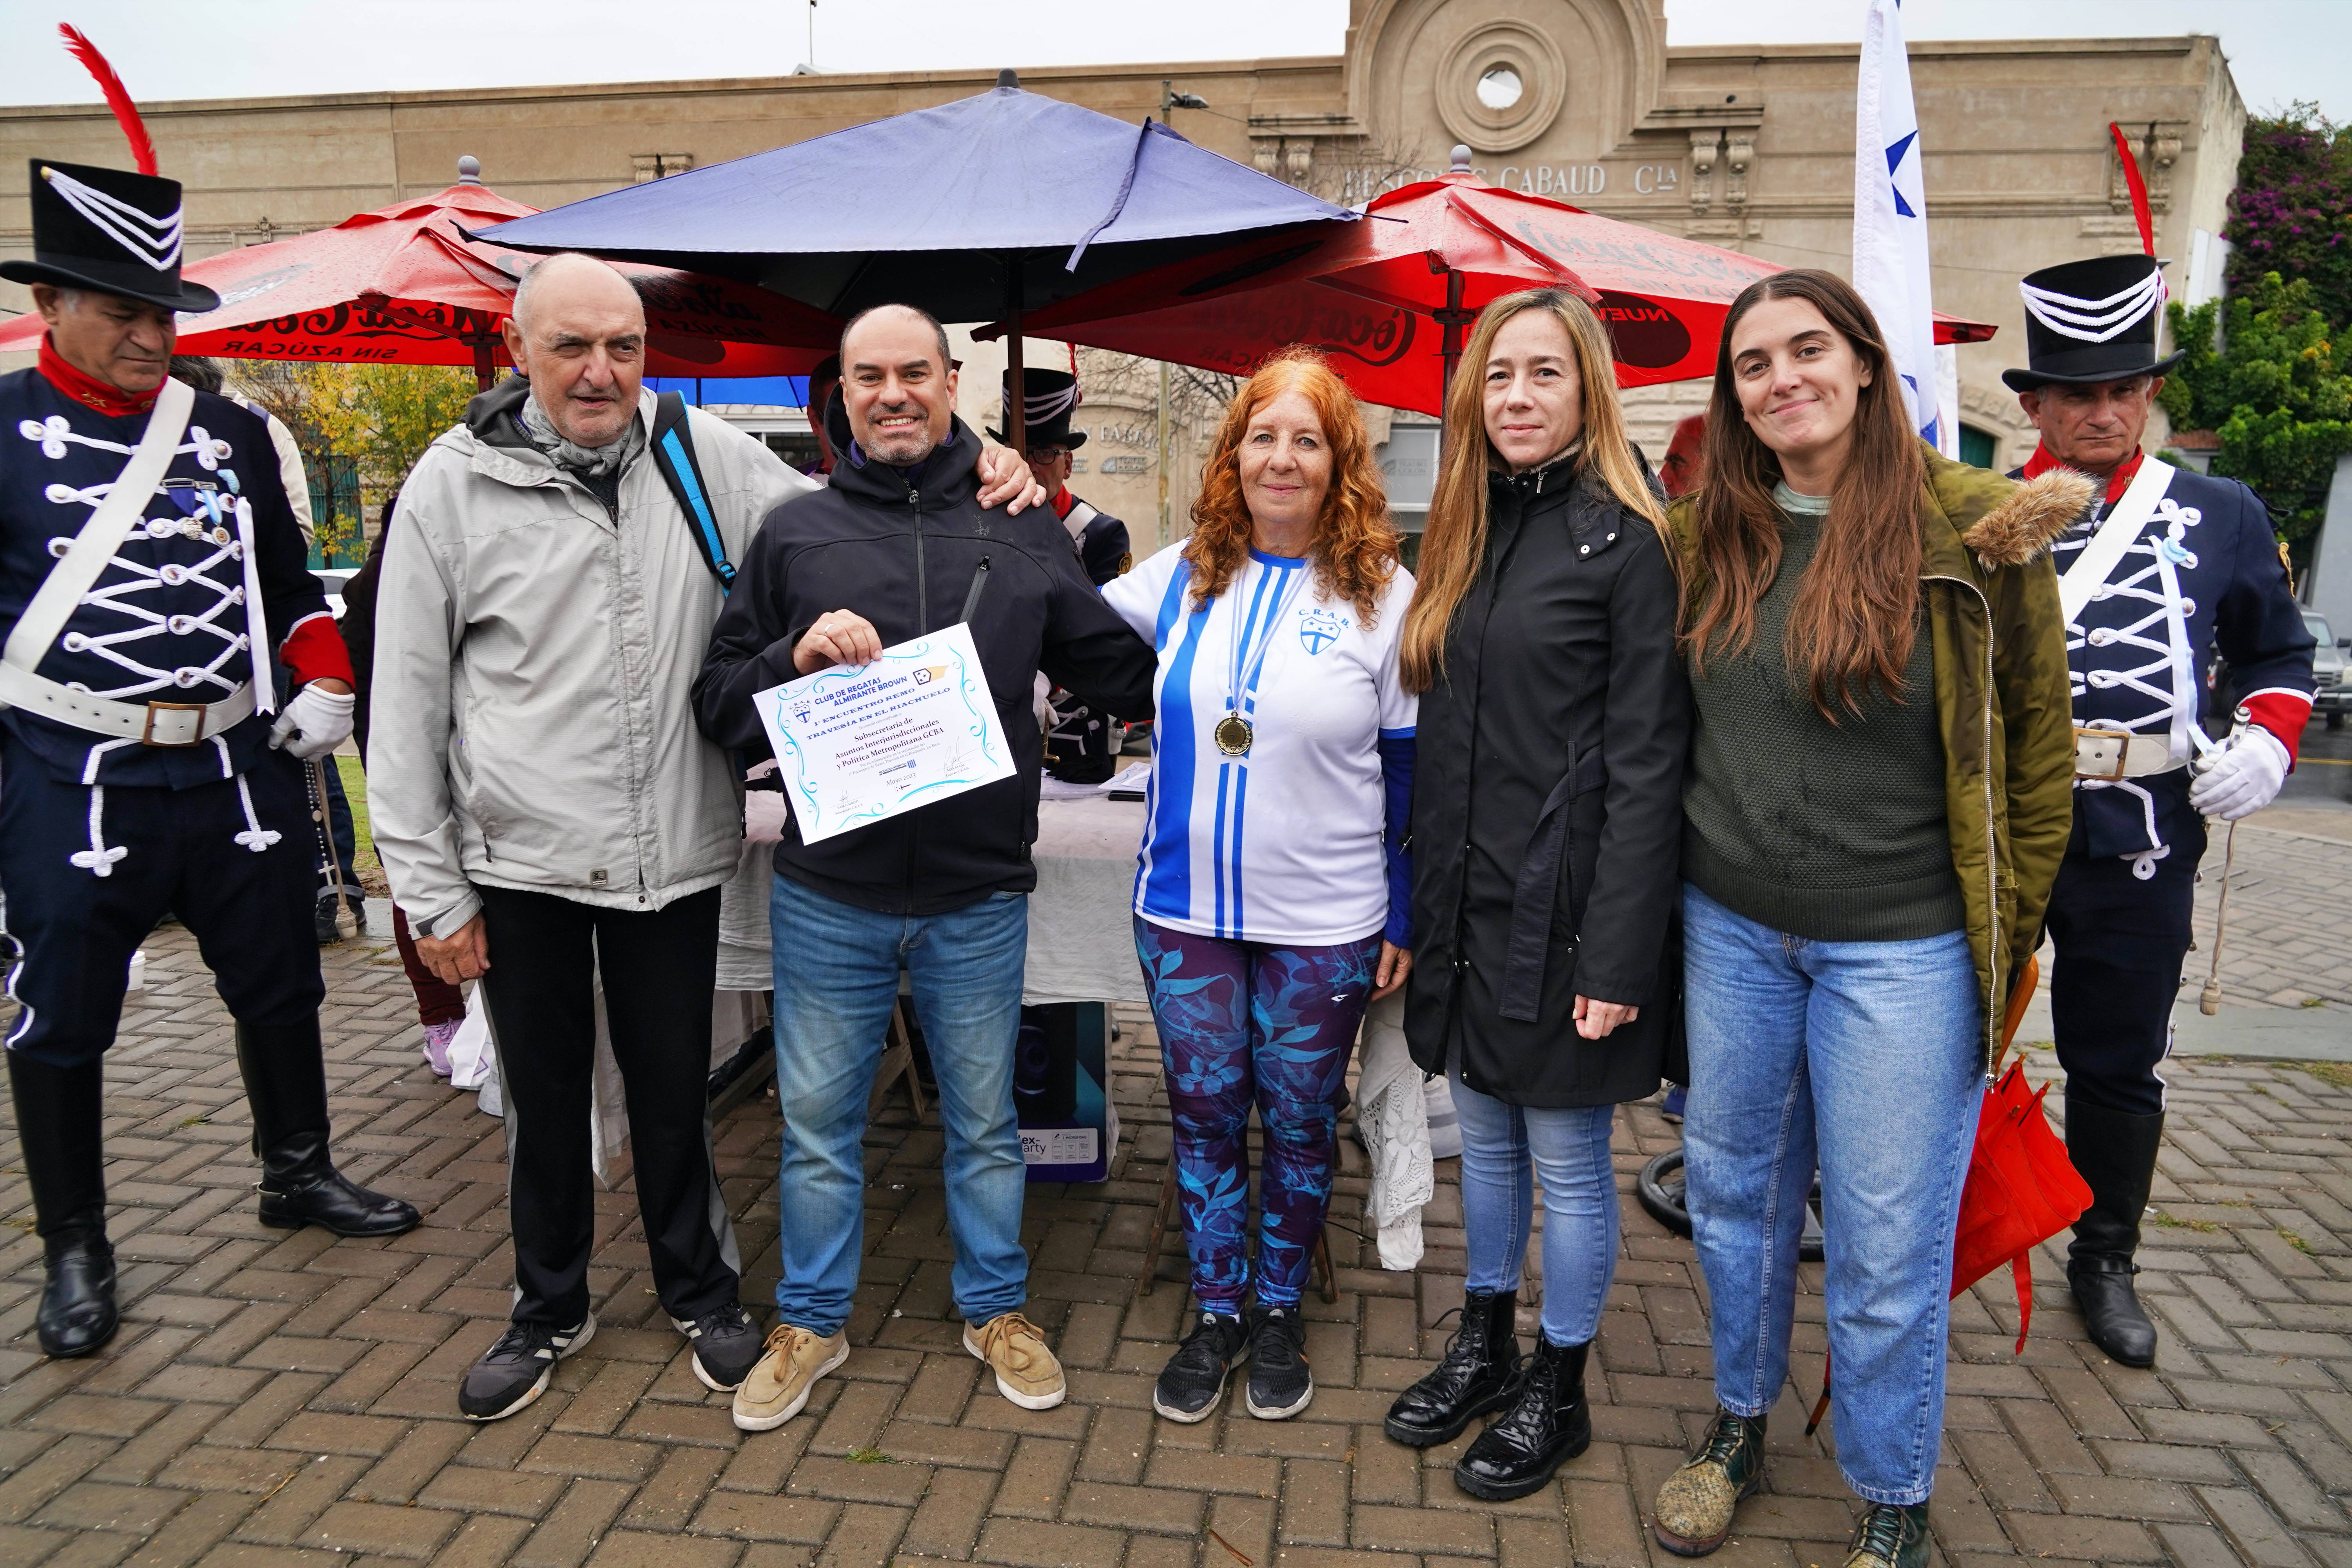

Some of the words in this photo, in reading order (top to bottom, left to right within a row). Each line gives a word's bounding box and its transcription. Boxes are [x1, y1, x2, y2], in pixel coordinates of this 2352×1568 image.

[1500, 166, 1606, 194] CABAUD
[815, 693, 835, 705] CLUB
[836, 690, 846, 698] DE
[847, 677, 881, 693] REGATAS
[834, 686, 877, 707] ALMIRANTE
[878, 676, 908, 691] BROWN
[806, 719, 858, 740] TRAVESÍA
[859, 714, 873, 722] EN
[889, 688, 951, 711] RIACHUELO
[823, 699, 884, 724] ENCUENTRO
[885, 688, 915, 701] REMO
[835, 746, 864, 760] Asuntos
[865, 719, 940, 749] Interjurisdiccionales
[854, 720, 903, 742] Subsecretaría
[842, 754, 870, 767] Política
[871, 734, 922, 758] Metropolitana
[923, 727, 944, 739] GCBA
[886, 778, 902, 786] Mayo
[903, 773, 916, 781] 2023
[1022, 1143, 1046, 1154] arty
